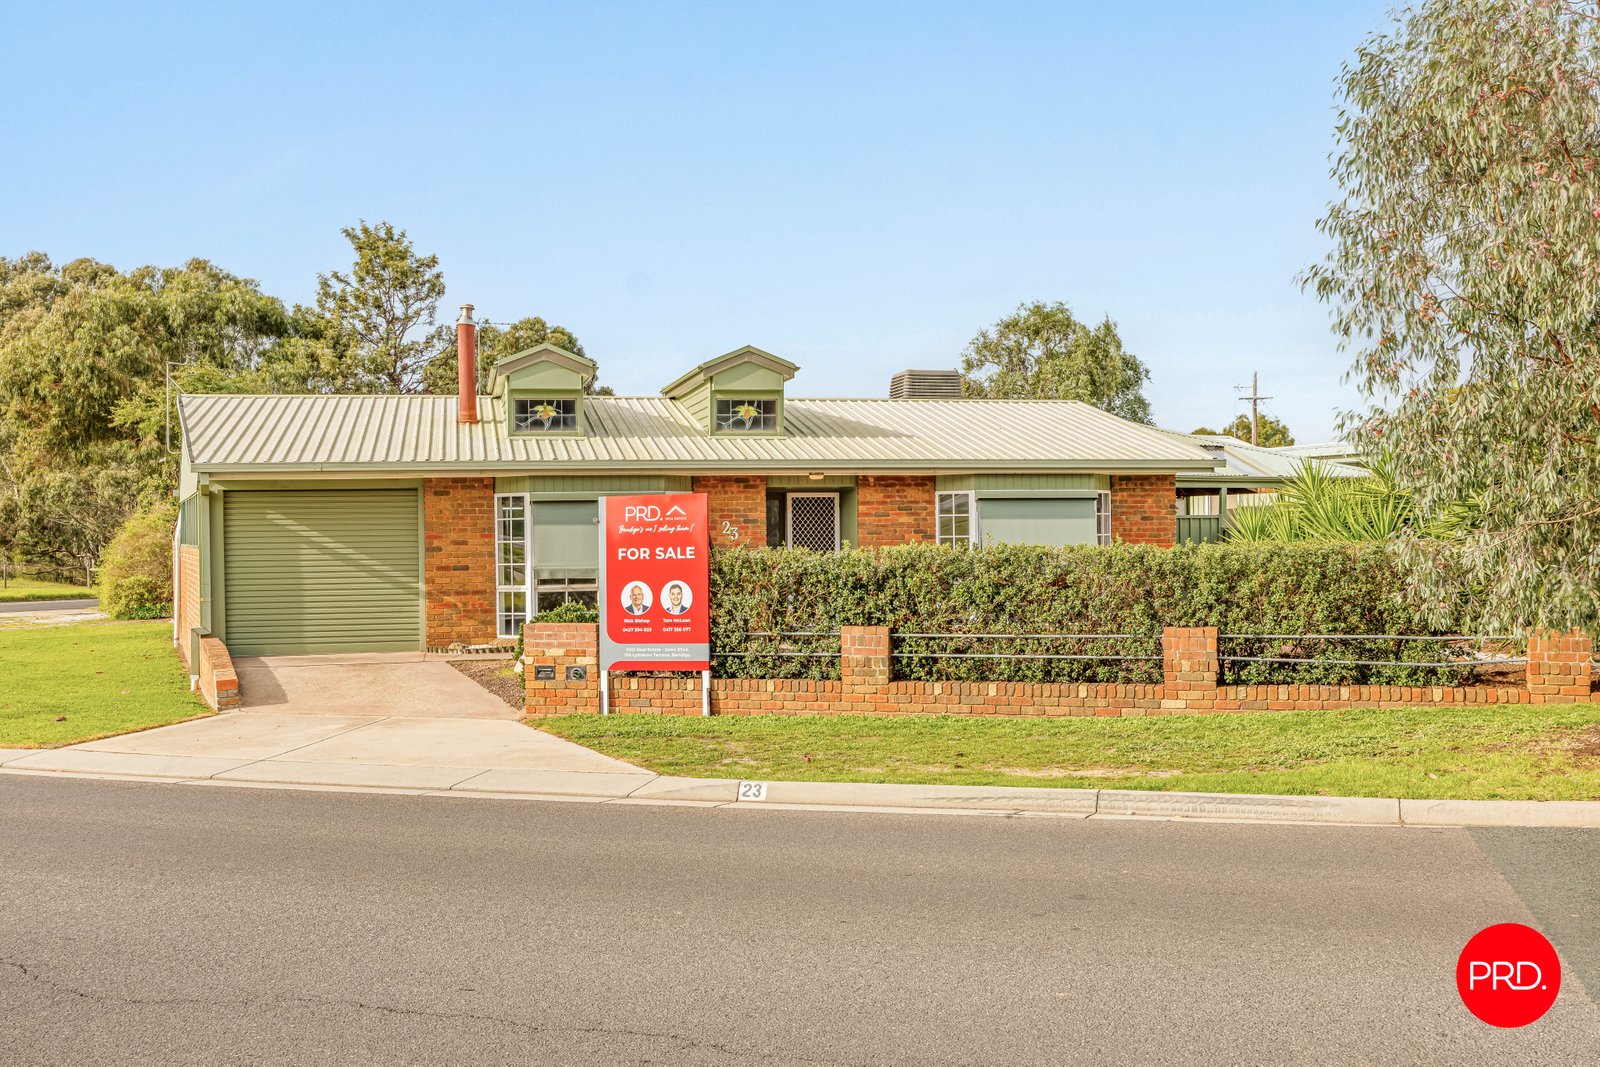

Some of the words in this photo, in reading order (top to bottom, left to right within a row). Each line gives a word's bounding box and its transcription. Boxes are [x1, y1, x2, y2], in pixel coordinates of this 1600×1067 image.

[722, 520, 739, 540] 23
[618, 548, 650, 560] FOR
[655, 546, 696, 560] SALE
[742, 783, 762, 798] 23
